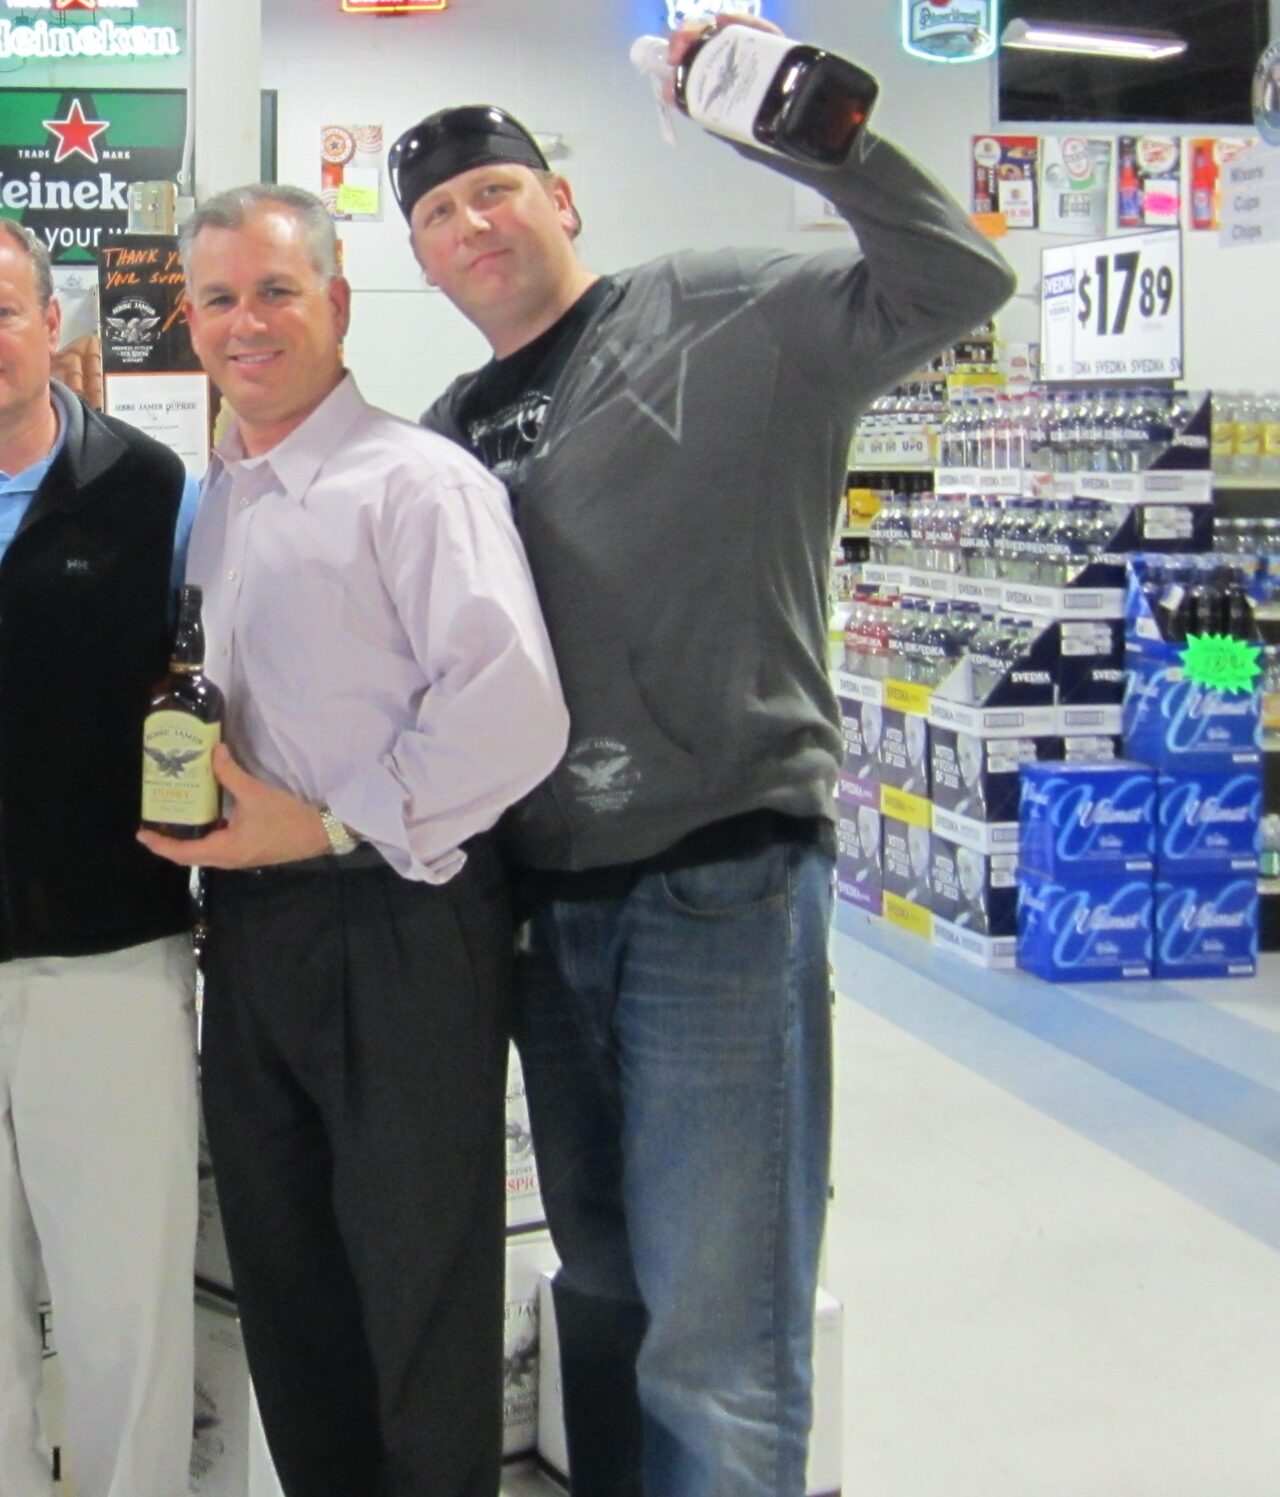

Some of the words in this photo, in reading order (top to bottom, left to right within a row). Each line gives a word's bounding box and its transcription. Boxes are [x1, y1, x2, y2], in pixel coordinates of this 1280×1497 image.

[19, 150, 50, 158] TRADE
[102, 151, 131, 159] MARK
[45, 226, 102, 252] your
[102, 248, 159, 268] THANK
[106, 271, 141, 289] YOUR
[507, 1175, 538, 1193] SPIC
